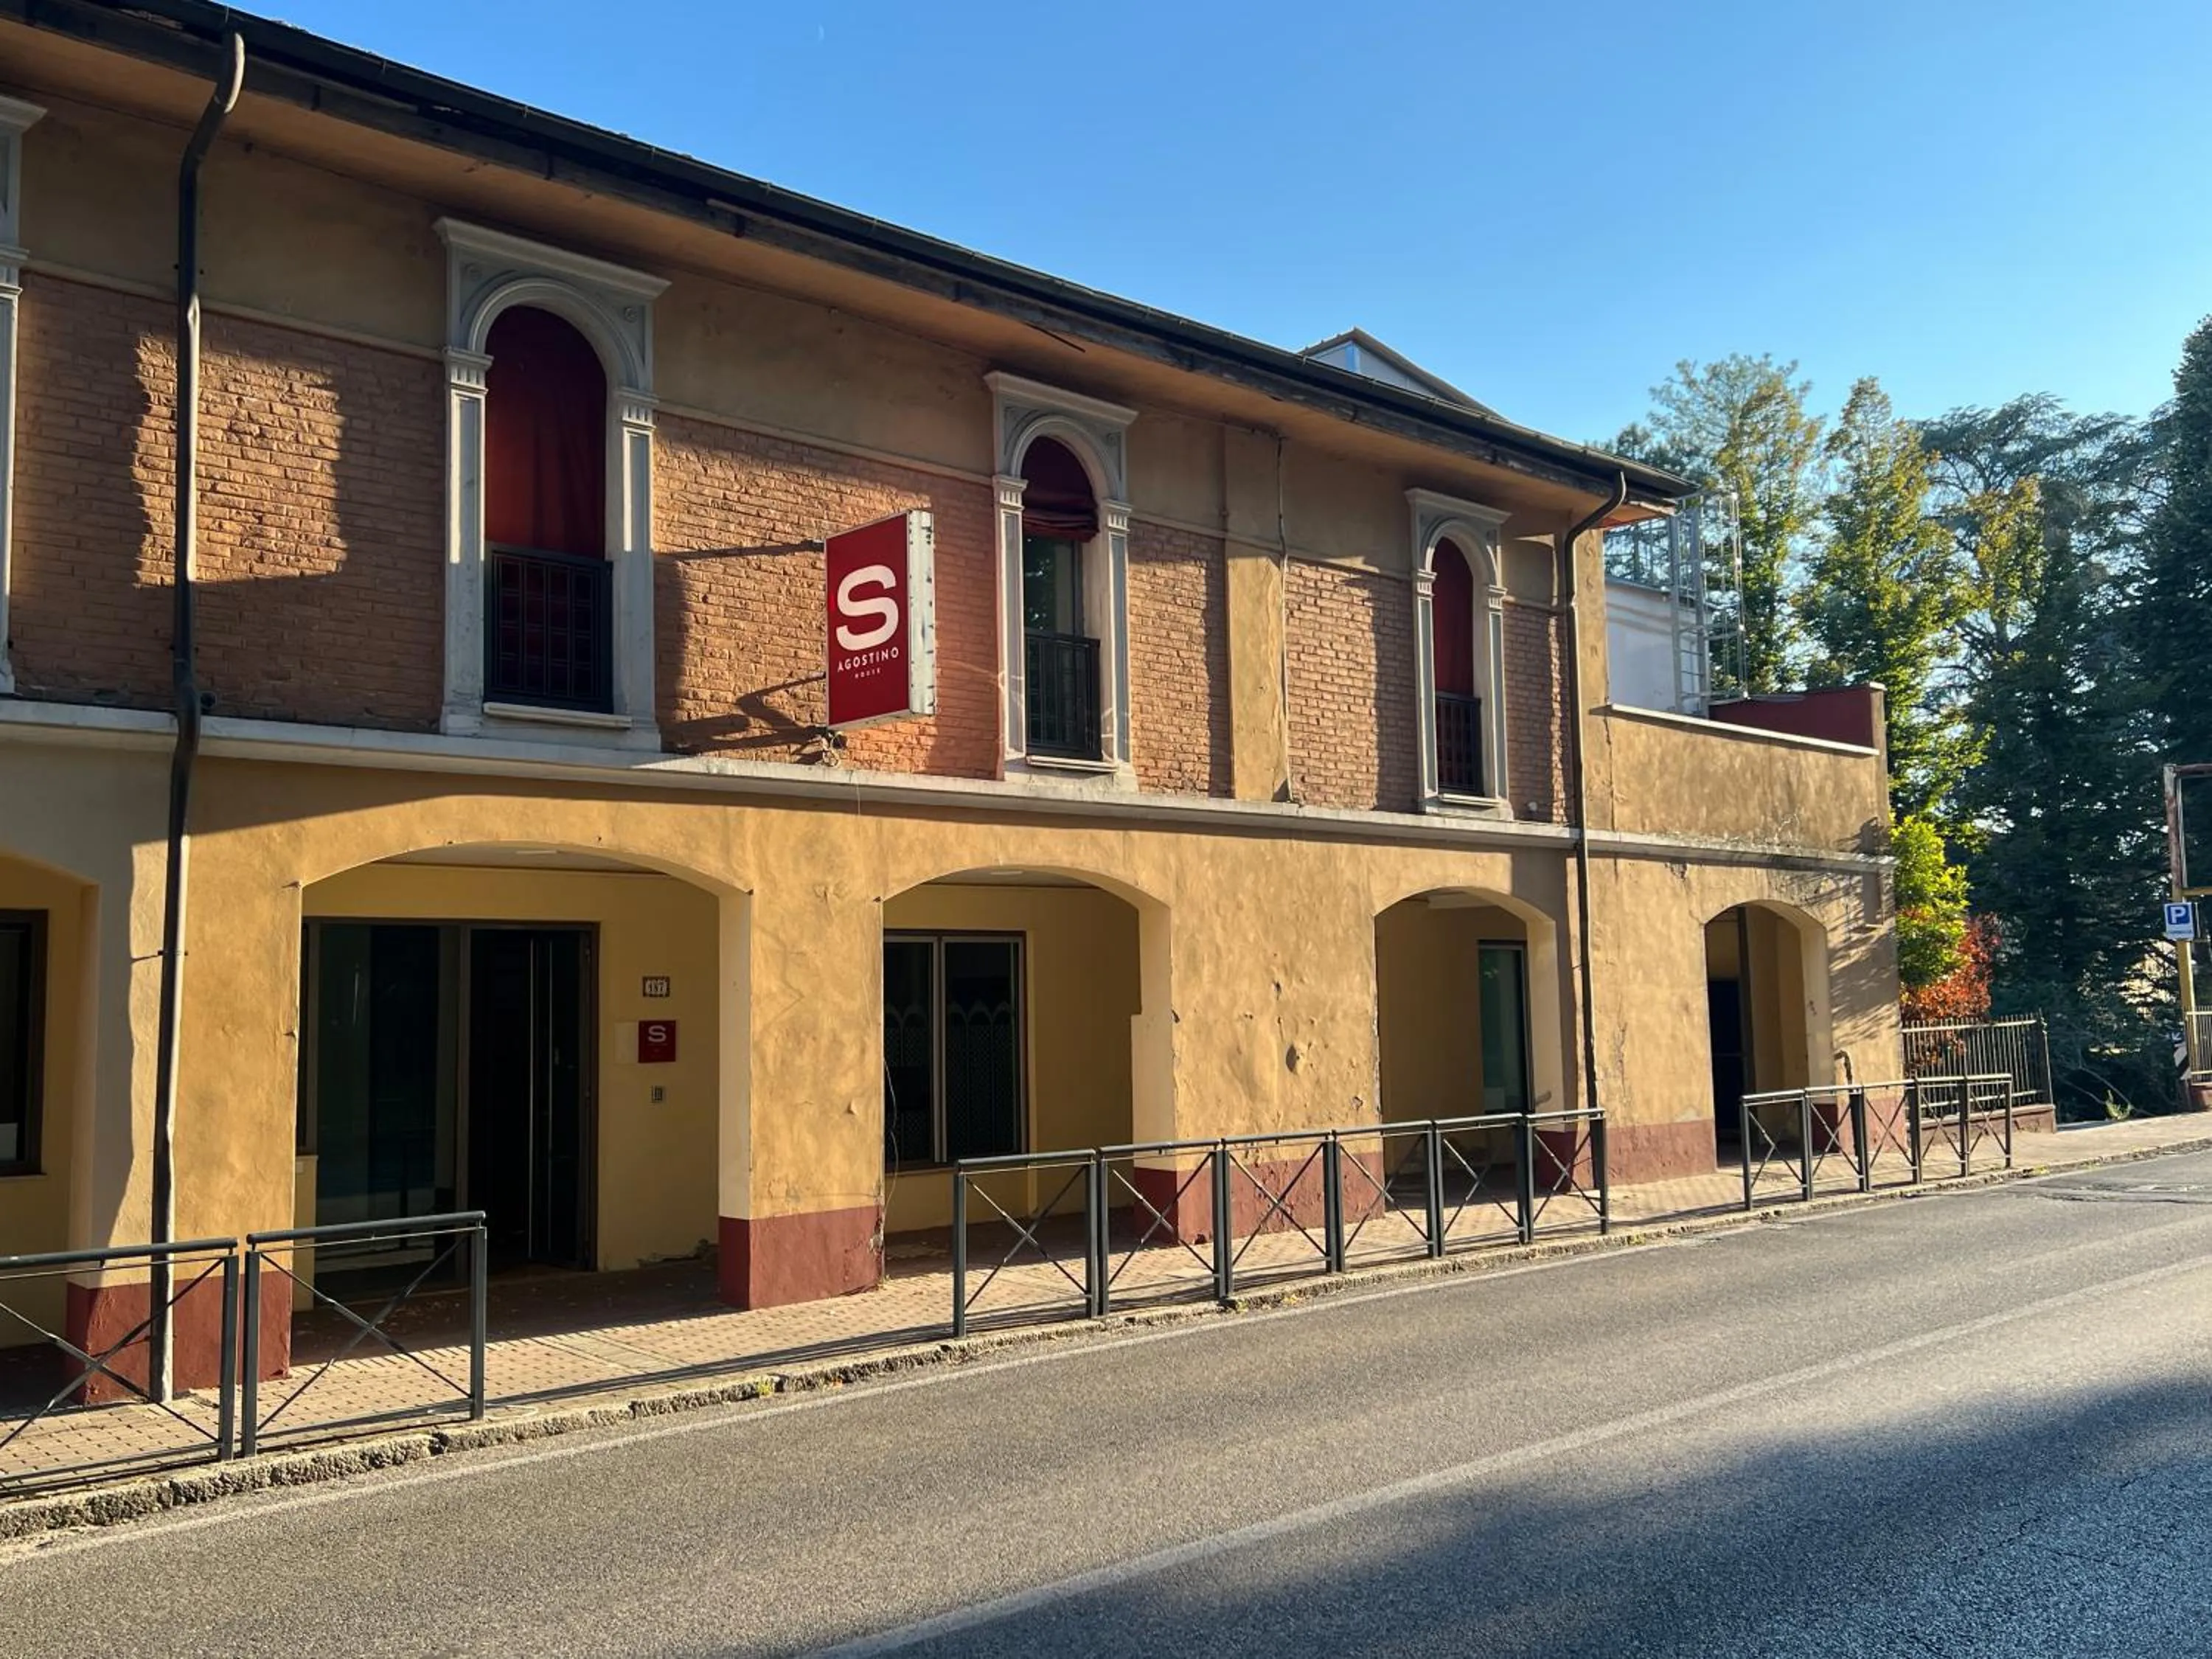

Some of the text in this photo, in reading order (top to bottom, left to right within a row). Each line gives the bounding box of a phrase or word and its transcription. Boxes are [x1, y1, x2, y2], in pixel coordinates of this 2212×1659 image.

[835, 564, 899, 651] S
[837, 646, 899, 672] AGOSTINO
[2170, 906, 2186, 924] P
[648, 1024, 667, 1043] S
